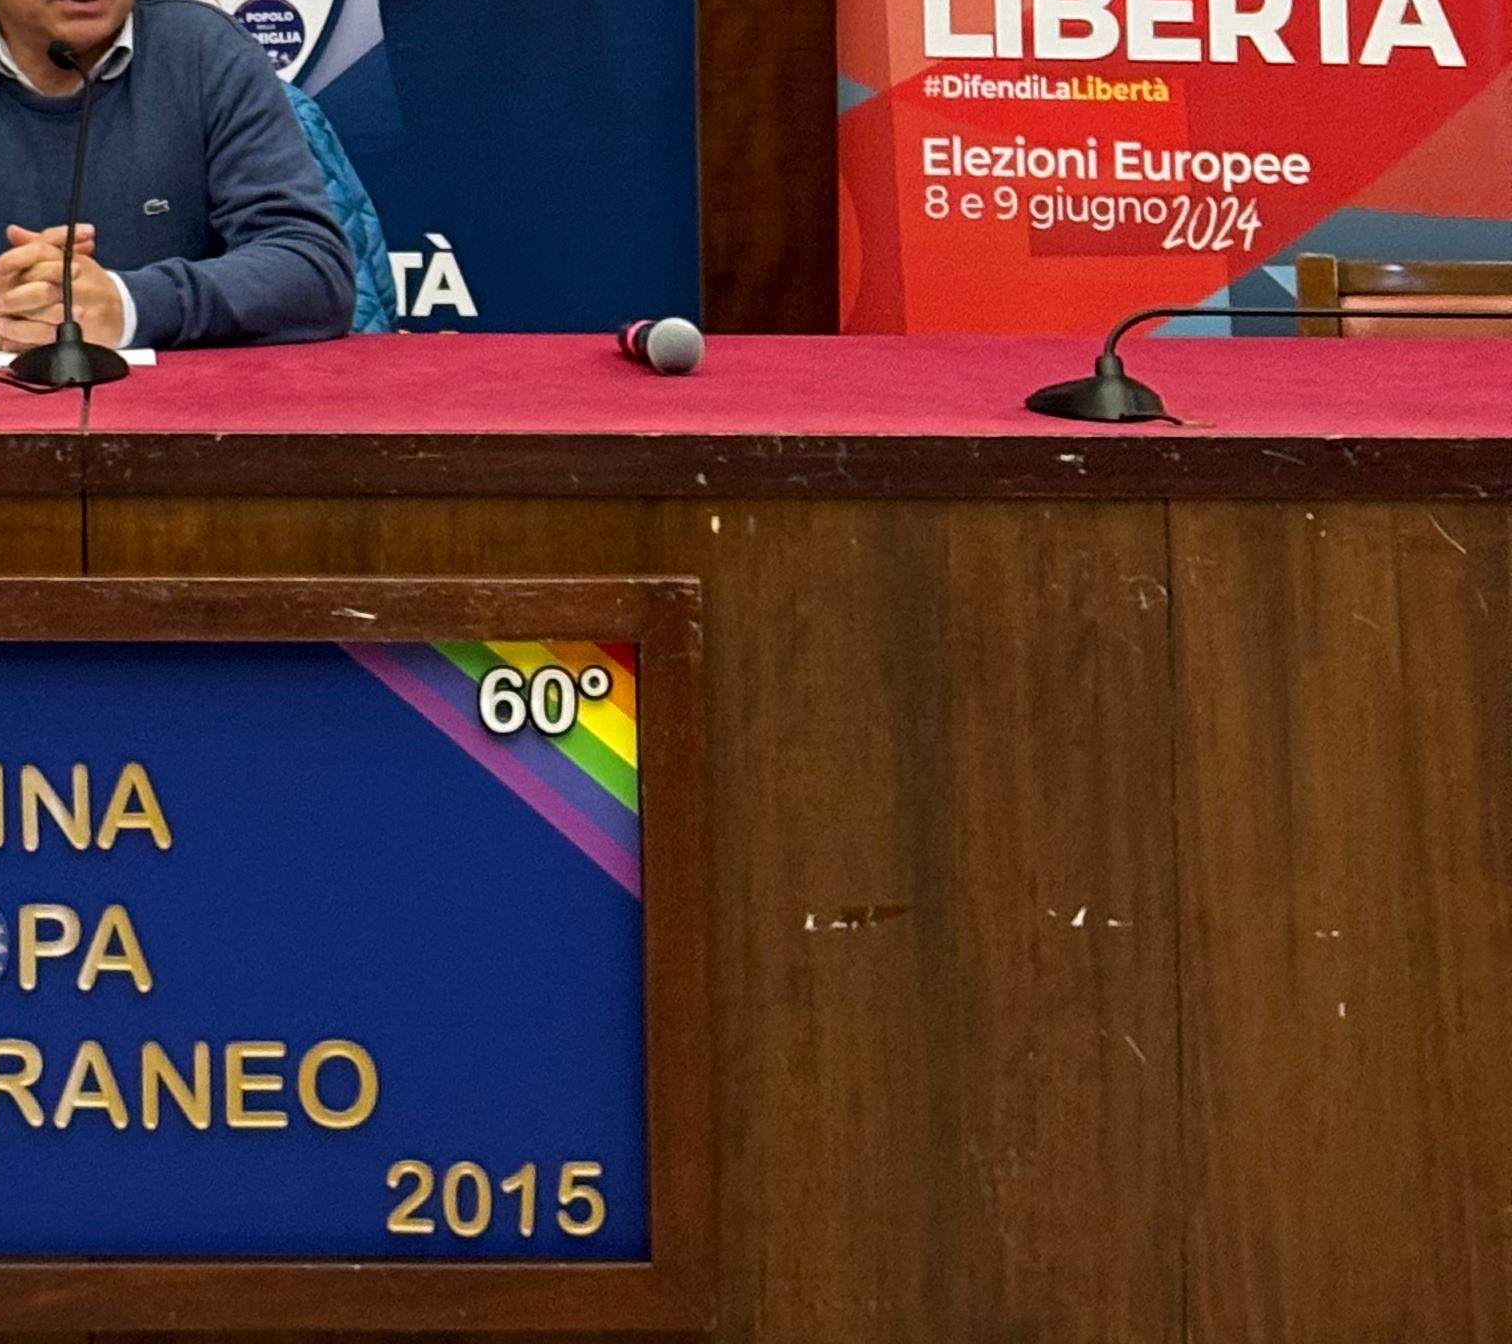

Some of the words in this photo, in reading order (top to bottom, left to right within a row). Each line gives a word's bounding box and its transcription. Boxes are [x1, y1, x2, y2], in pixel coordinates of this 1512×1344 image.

[246, 11, 295, 24] POPOLO
[253, 31, 303, 45] MIGLIA
[923, 74, 1171, 103] #DifendiLaLibertà
[922, 134, 1098, 181] Elezioni
[1114, 140, 1311, 191] Europee
[924, 185, 950, 219] 8
[961, 192, 984, 219] e
[993, 186, 1019, 220] 9
[1029, 185, 1168, 231] giugno
[1162, 194, 1262, 252] 2024
[477, 663, 614, 738] 60°
[383, 1158, 610, 1239] 2015
